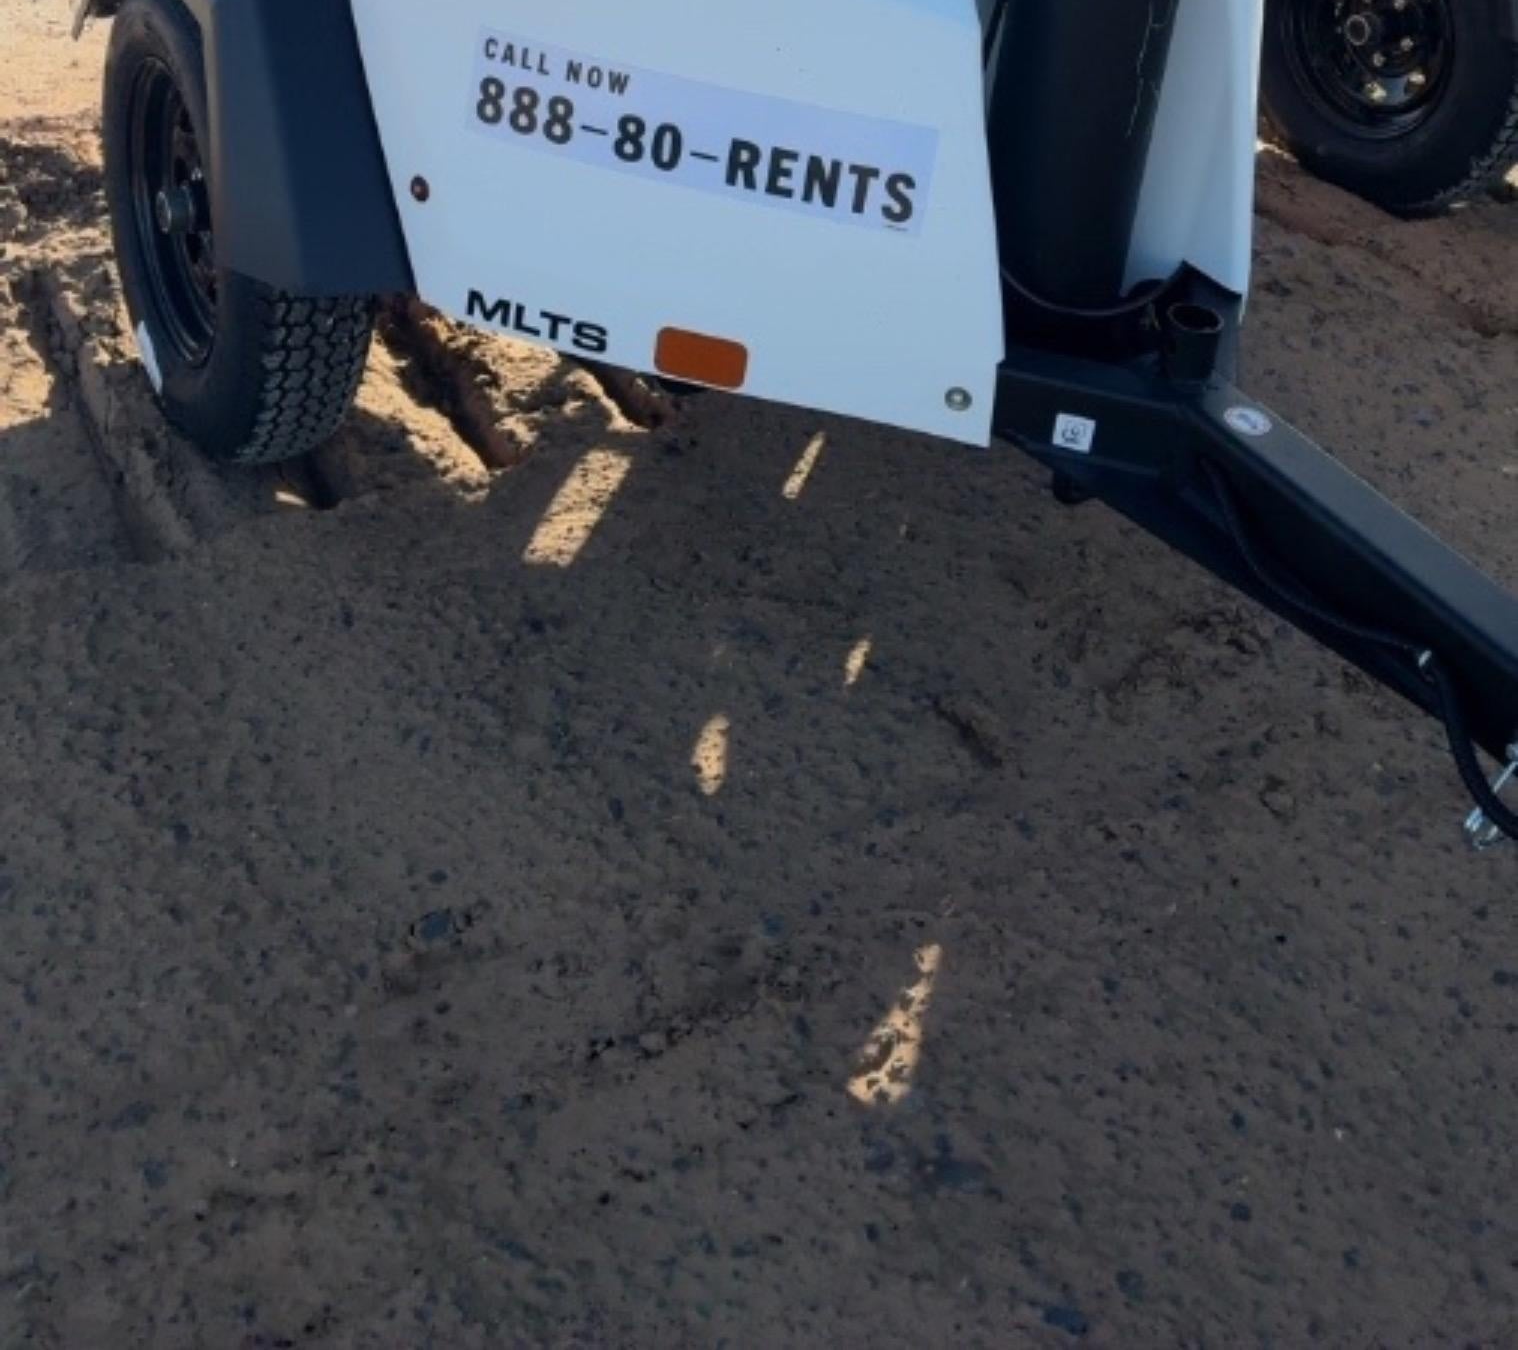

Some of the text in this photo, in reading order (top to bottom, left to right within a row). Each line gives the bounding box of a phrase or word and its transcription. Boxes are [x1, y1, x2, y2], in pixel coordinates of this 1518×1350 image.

[483, 36, 633, 96] CALL NOW
[475, 76, 918, 224] 888-80-RENTS
[466, 288, 609, 354] MLTS
